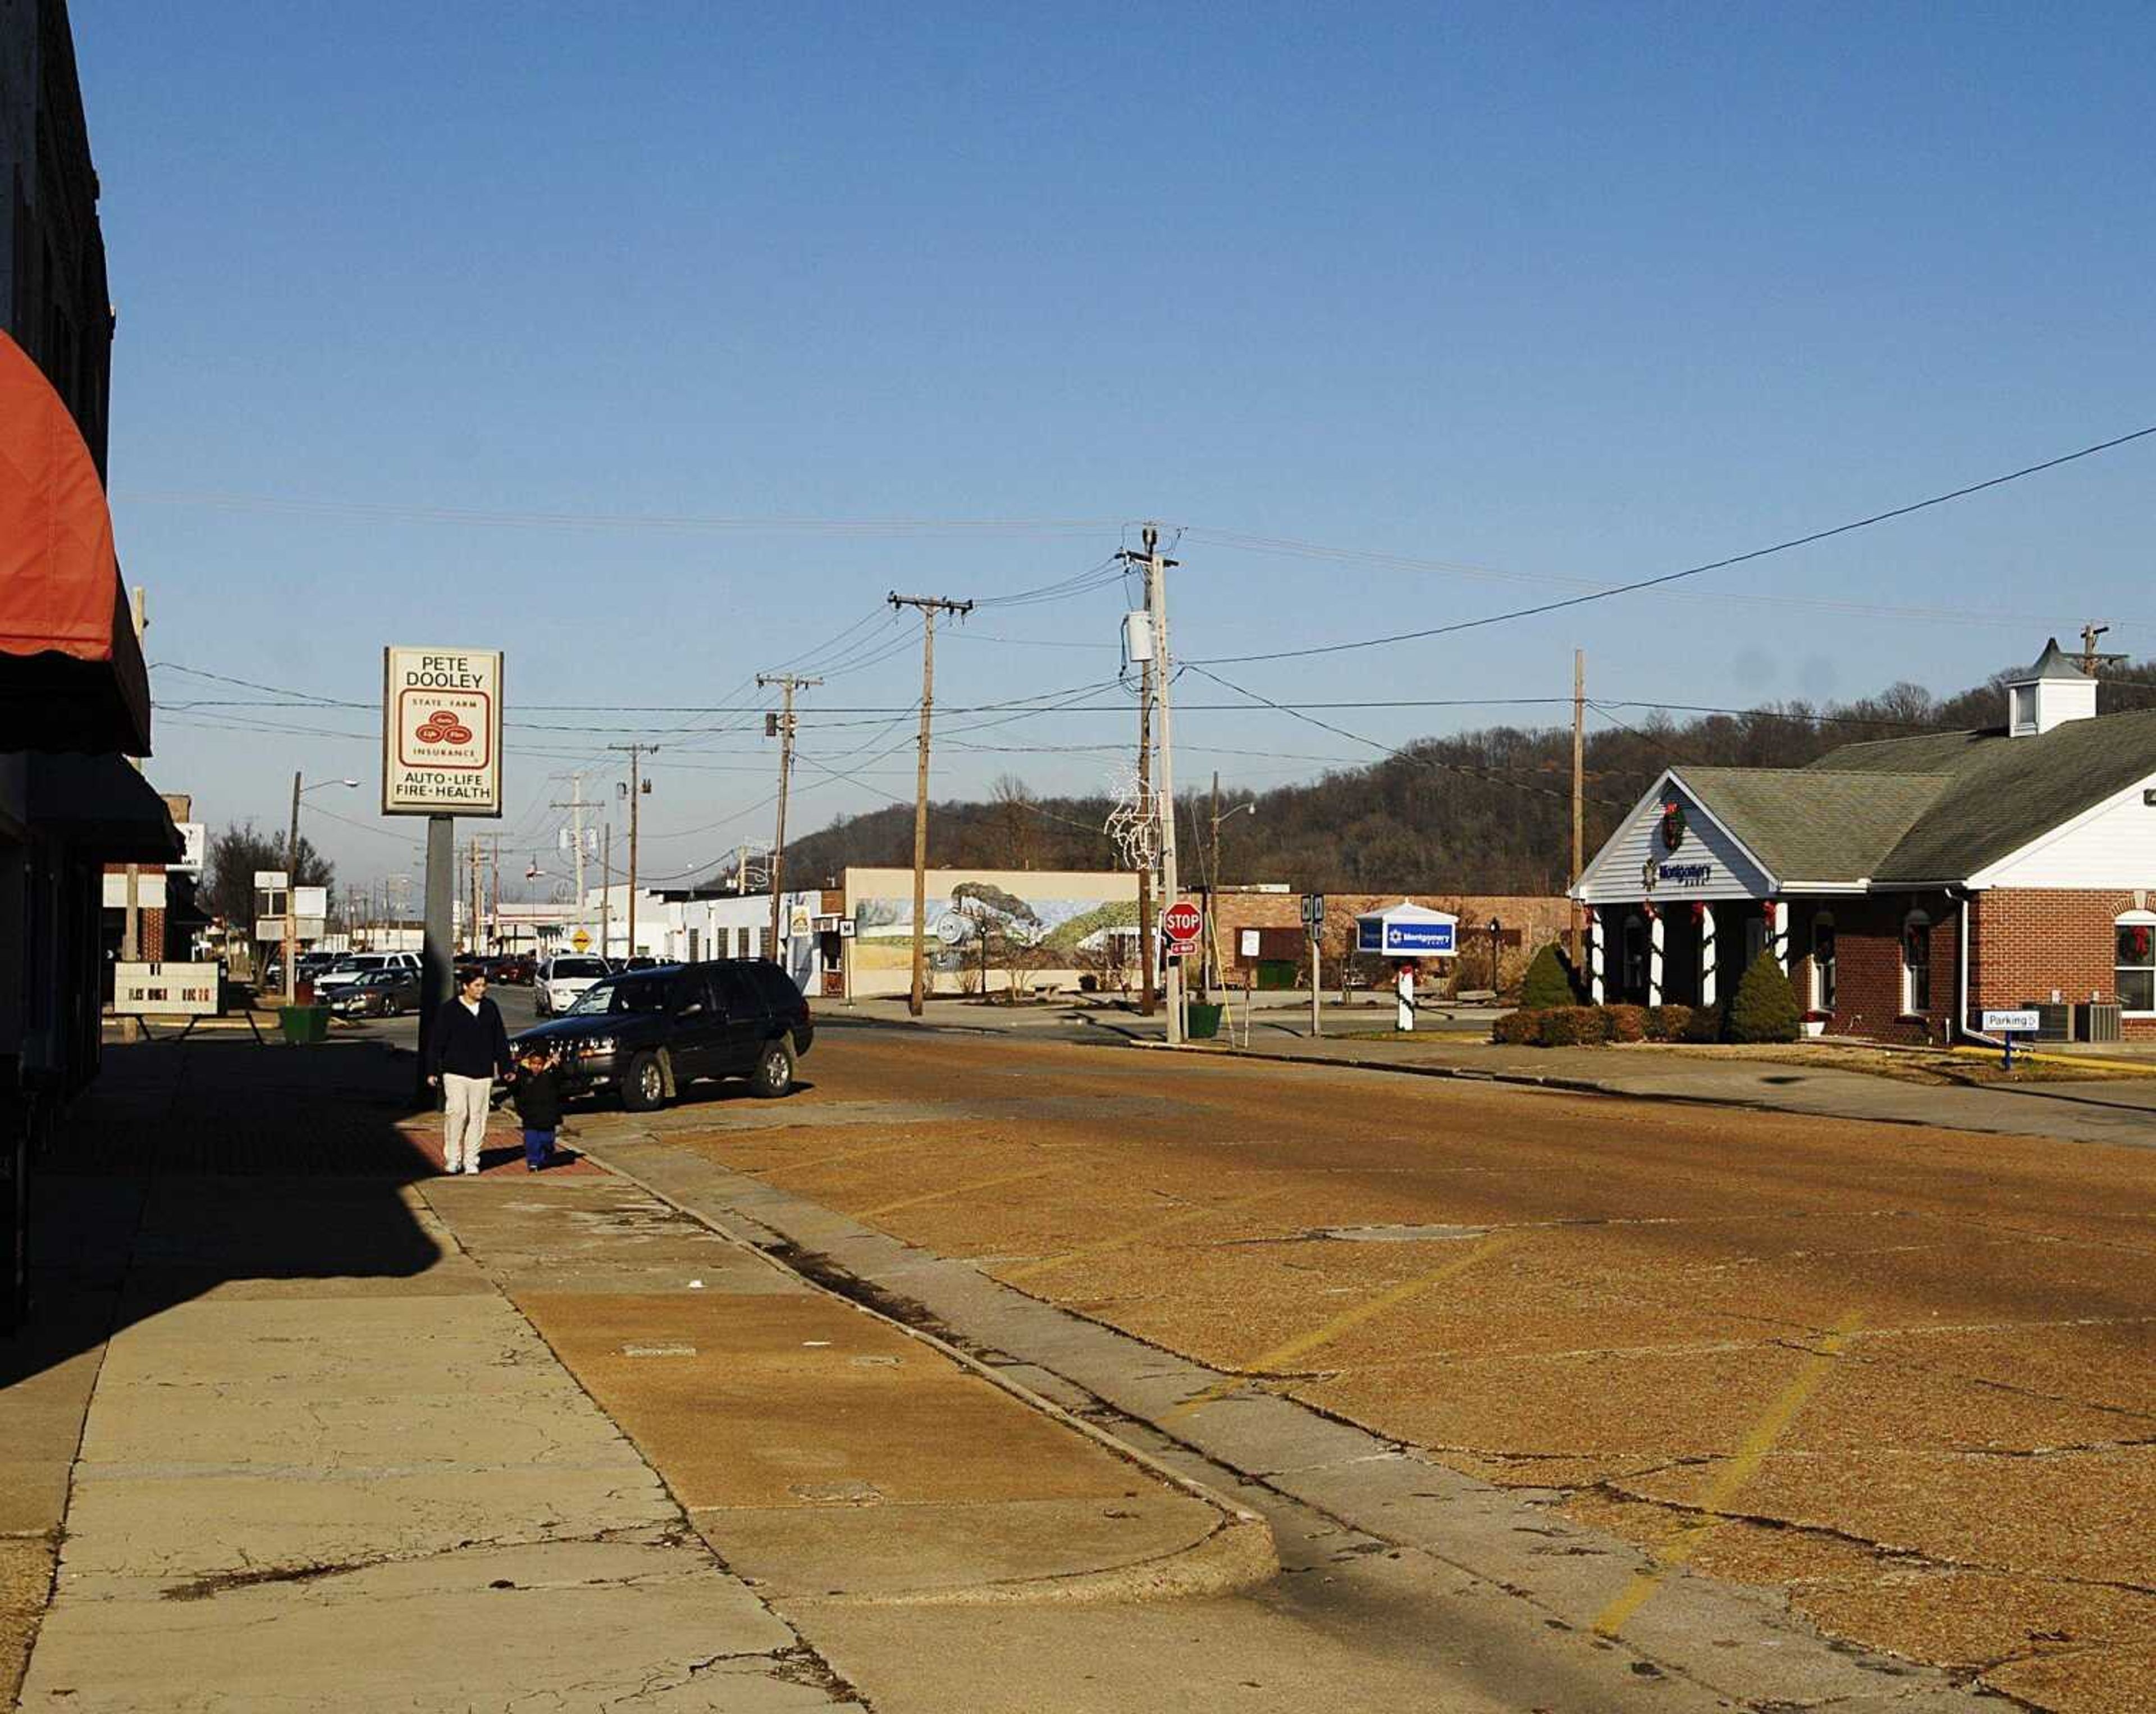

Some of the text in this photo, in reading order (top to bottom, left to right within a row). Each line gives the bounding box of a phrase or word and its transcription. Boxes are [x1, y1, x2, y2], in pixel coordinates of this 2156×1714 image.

[422, 657, 468, 672] PETE
[406, 672, 483, 688] DOOLEY
[1659, 864, 1711, 882] Montgomery
[1168, 914, 1199, 928] STOP
[1404, 933, 1450, 942] Montgomery
[1990, 1015, 2027, 1026] Parking
